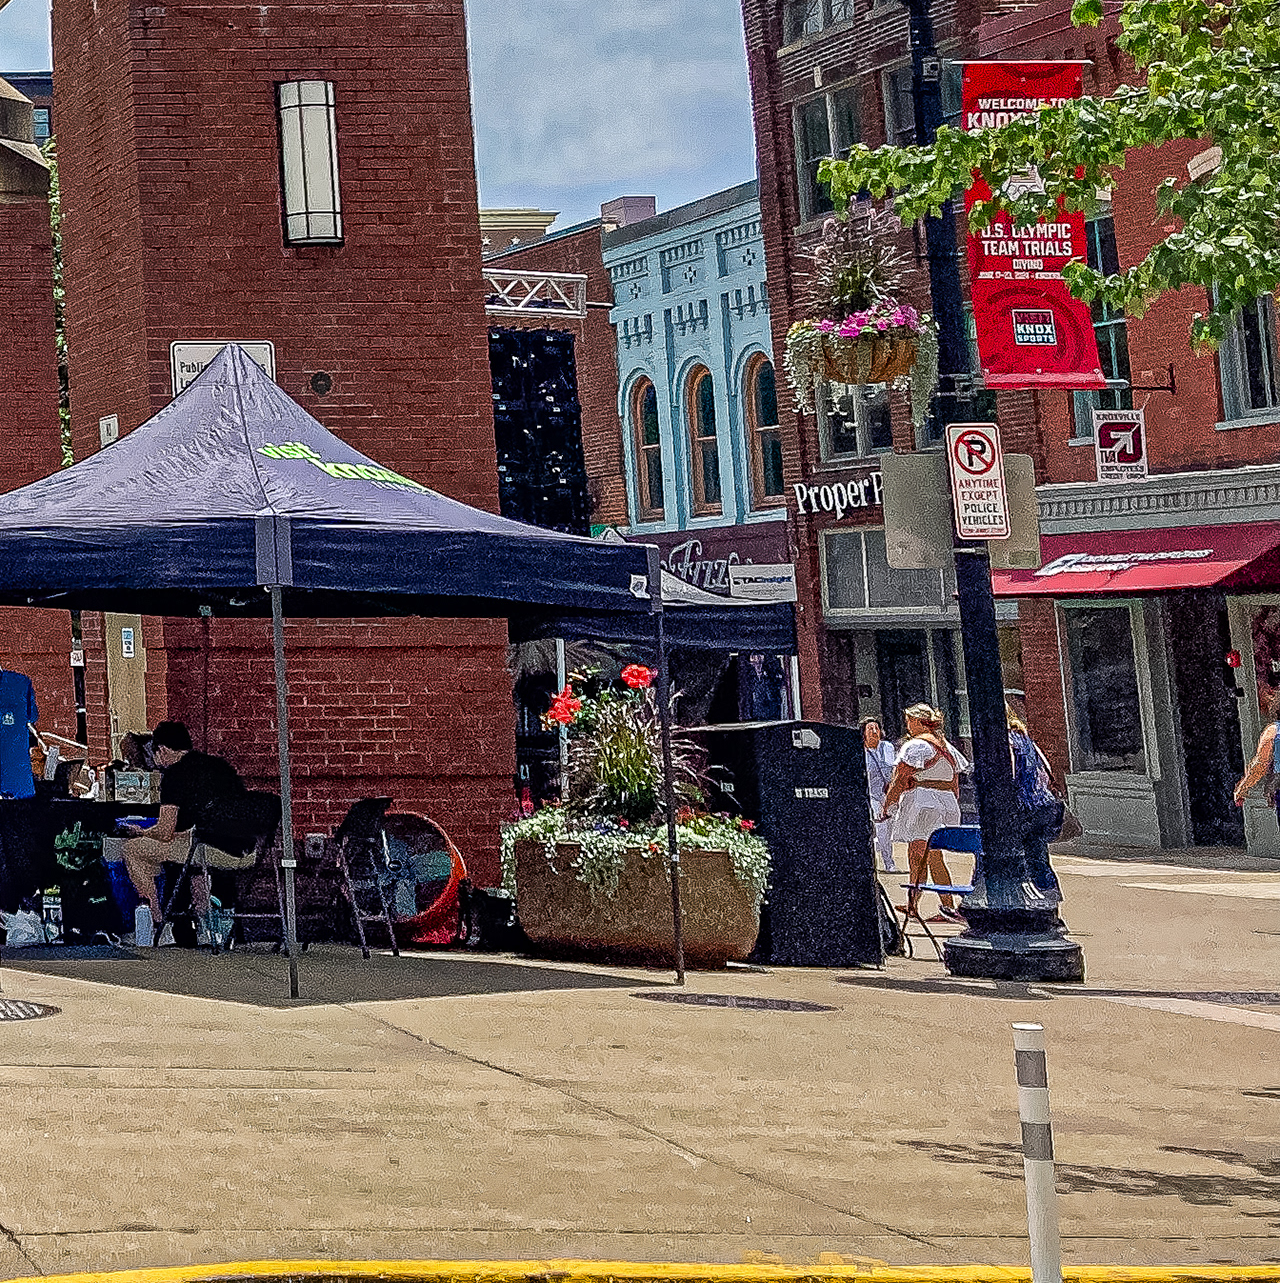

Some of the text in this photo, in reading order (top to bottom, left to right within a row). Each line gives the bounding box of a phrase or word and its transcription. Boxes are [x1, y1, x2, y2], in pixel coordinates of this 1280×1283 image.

[978, 98, 1045, 109] WELCOME
[981, 223, 1071, 238] U.S. OLYMPIC
[981, 240, 1072, 256] TEAM TRIALS
[1016, 323, 1053, 334] KNOX
[958, 478, 1000, 489] ANYTIME
[792, 478, 869, 520] Proper
[961, 490, 998, 501] EXCEPT
[963, 503, 999, 514] POLICE
[961, 515, 1004, 526] VEHICLES
